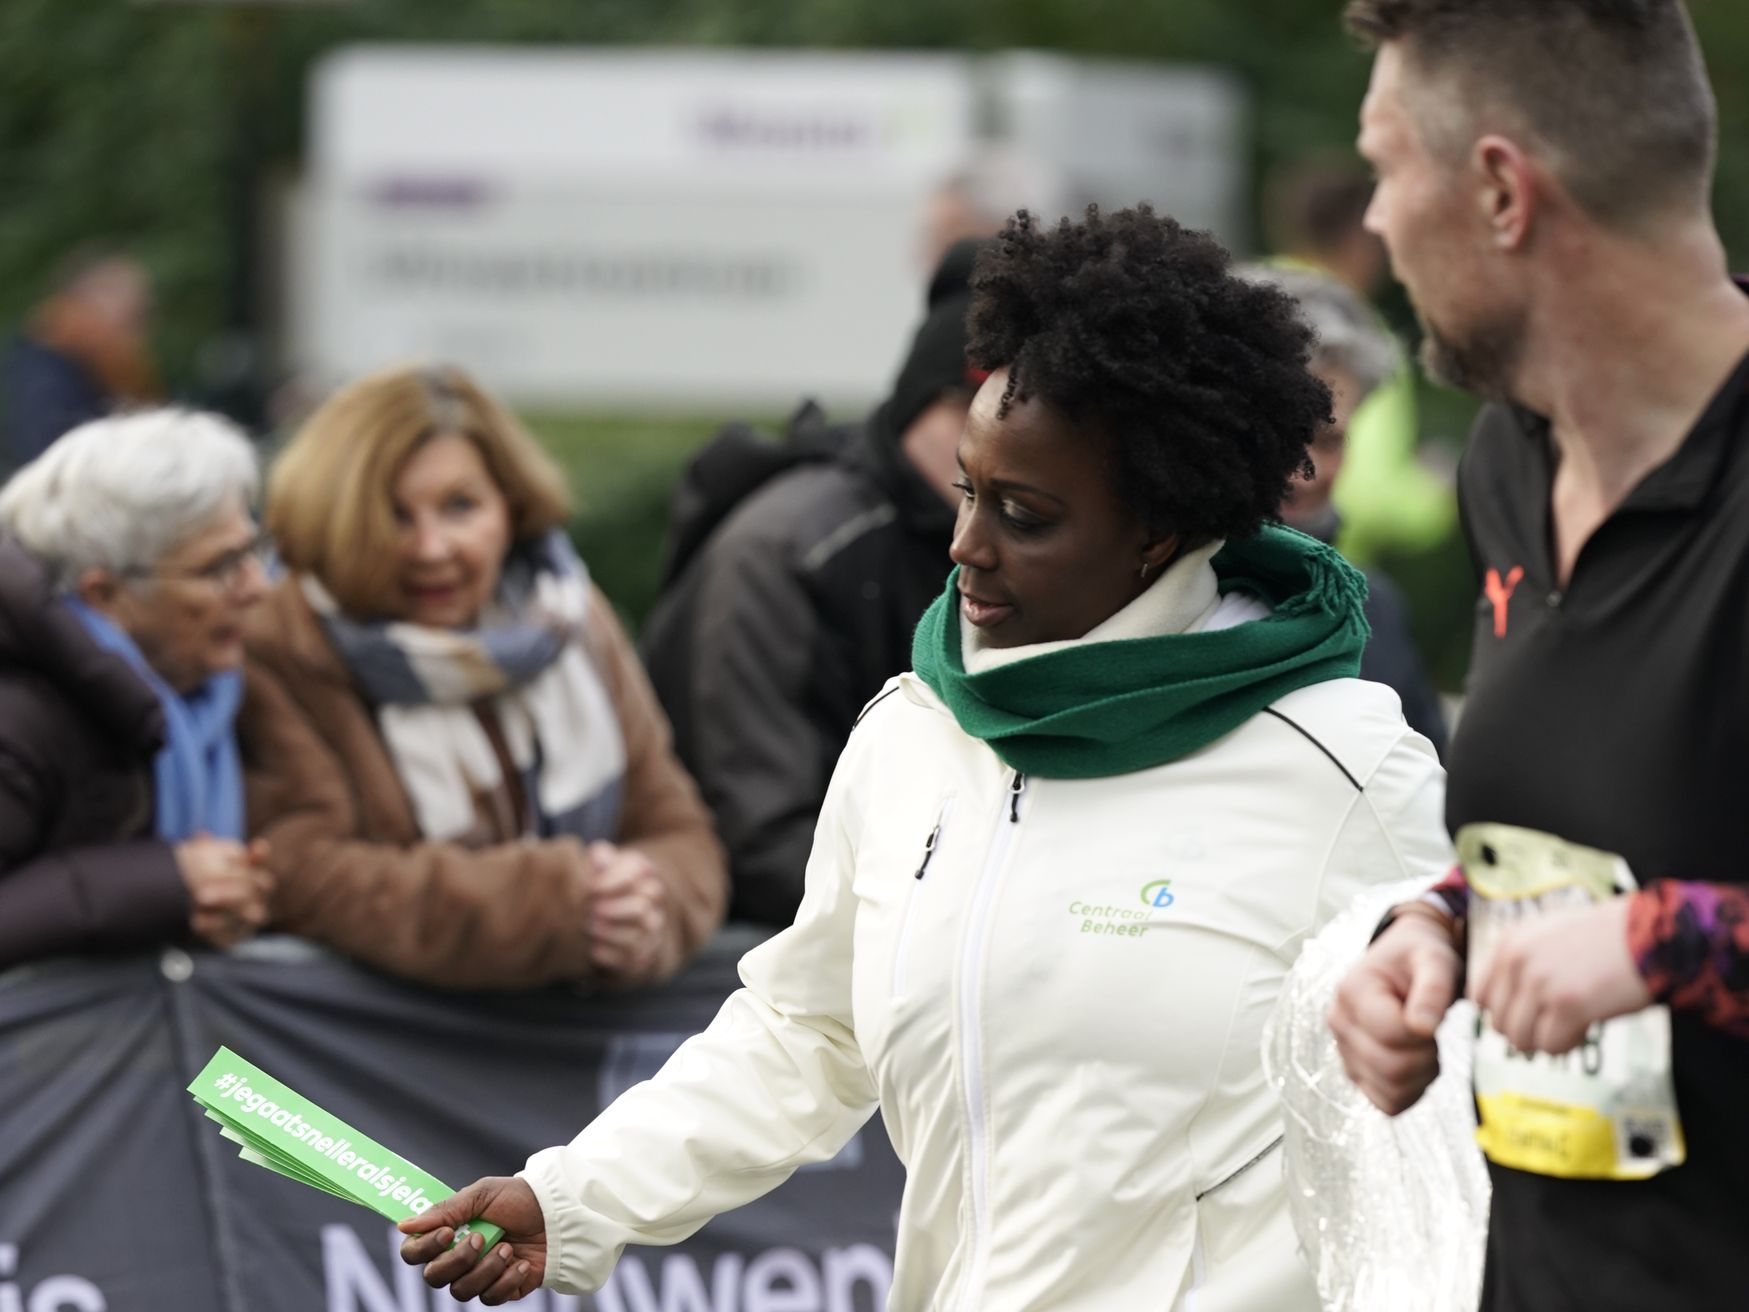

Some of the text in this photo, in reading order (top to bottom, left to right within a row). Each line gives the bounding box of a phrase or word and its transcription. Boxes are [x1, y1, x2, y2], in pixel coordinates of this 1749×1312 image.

[1068, 900, 1153, 922] Centraal
[1080, 918, 1149, 937] Beheer
[213, 1072, 471, 1243] #jegaatsnelleralsjelat
